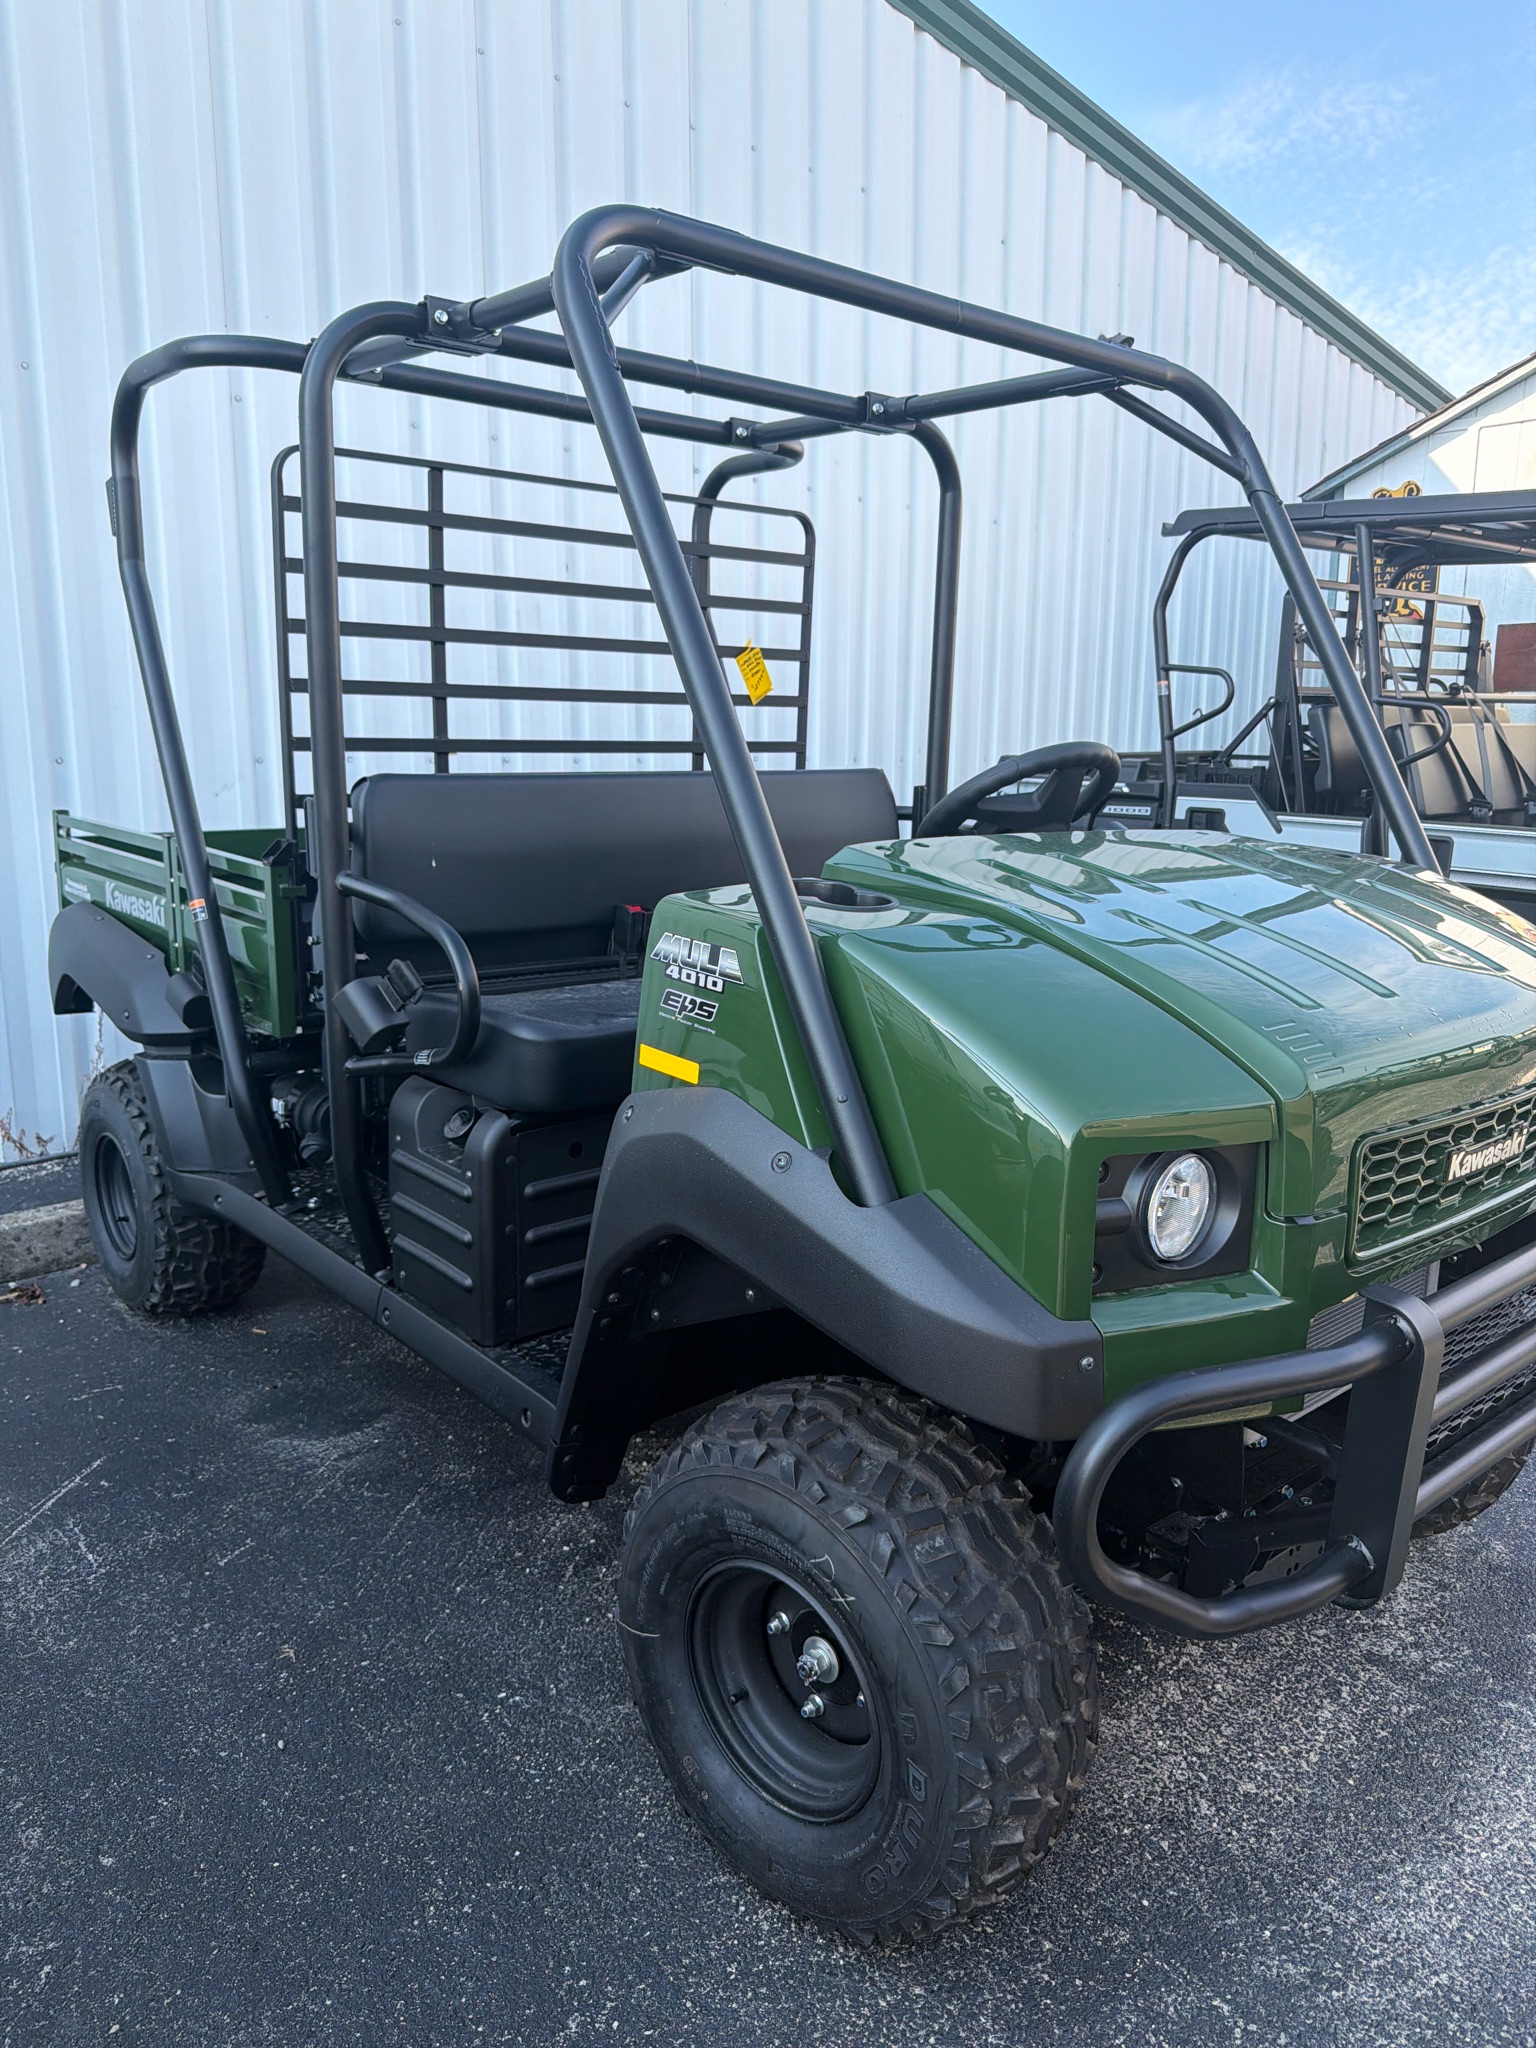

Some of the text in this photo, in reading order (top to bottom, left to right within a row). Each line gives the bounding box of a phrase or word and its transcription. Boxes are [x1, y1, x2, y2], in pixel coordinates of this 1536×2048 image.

[104, 880, 167, 927] Kawasaki
[650, 932, 744, 985] MULE
[665, 965, 724, 993] 4010
[658, 1011, 716, 1035] Electric Power Steering
[1447, 1127, 1528, 1182] Kawasaki
